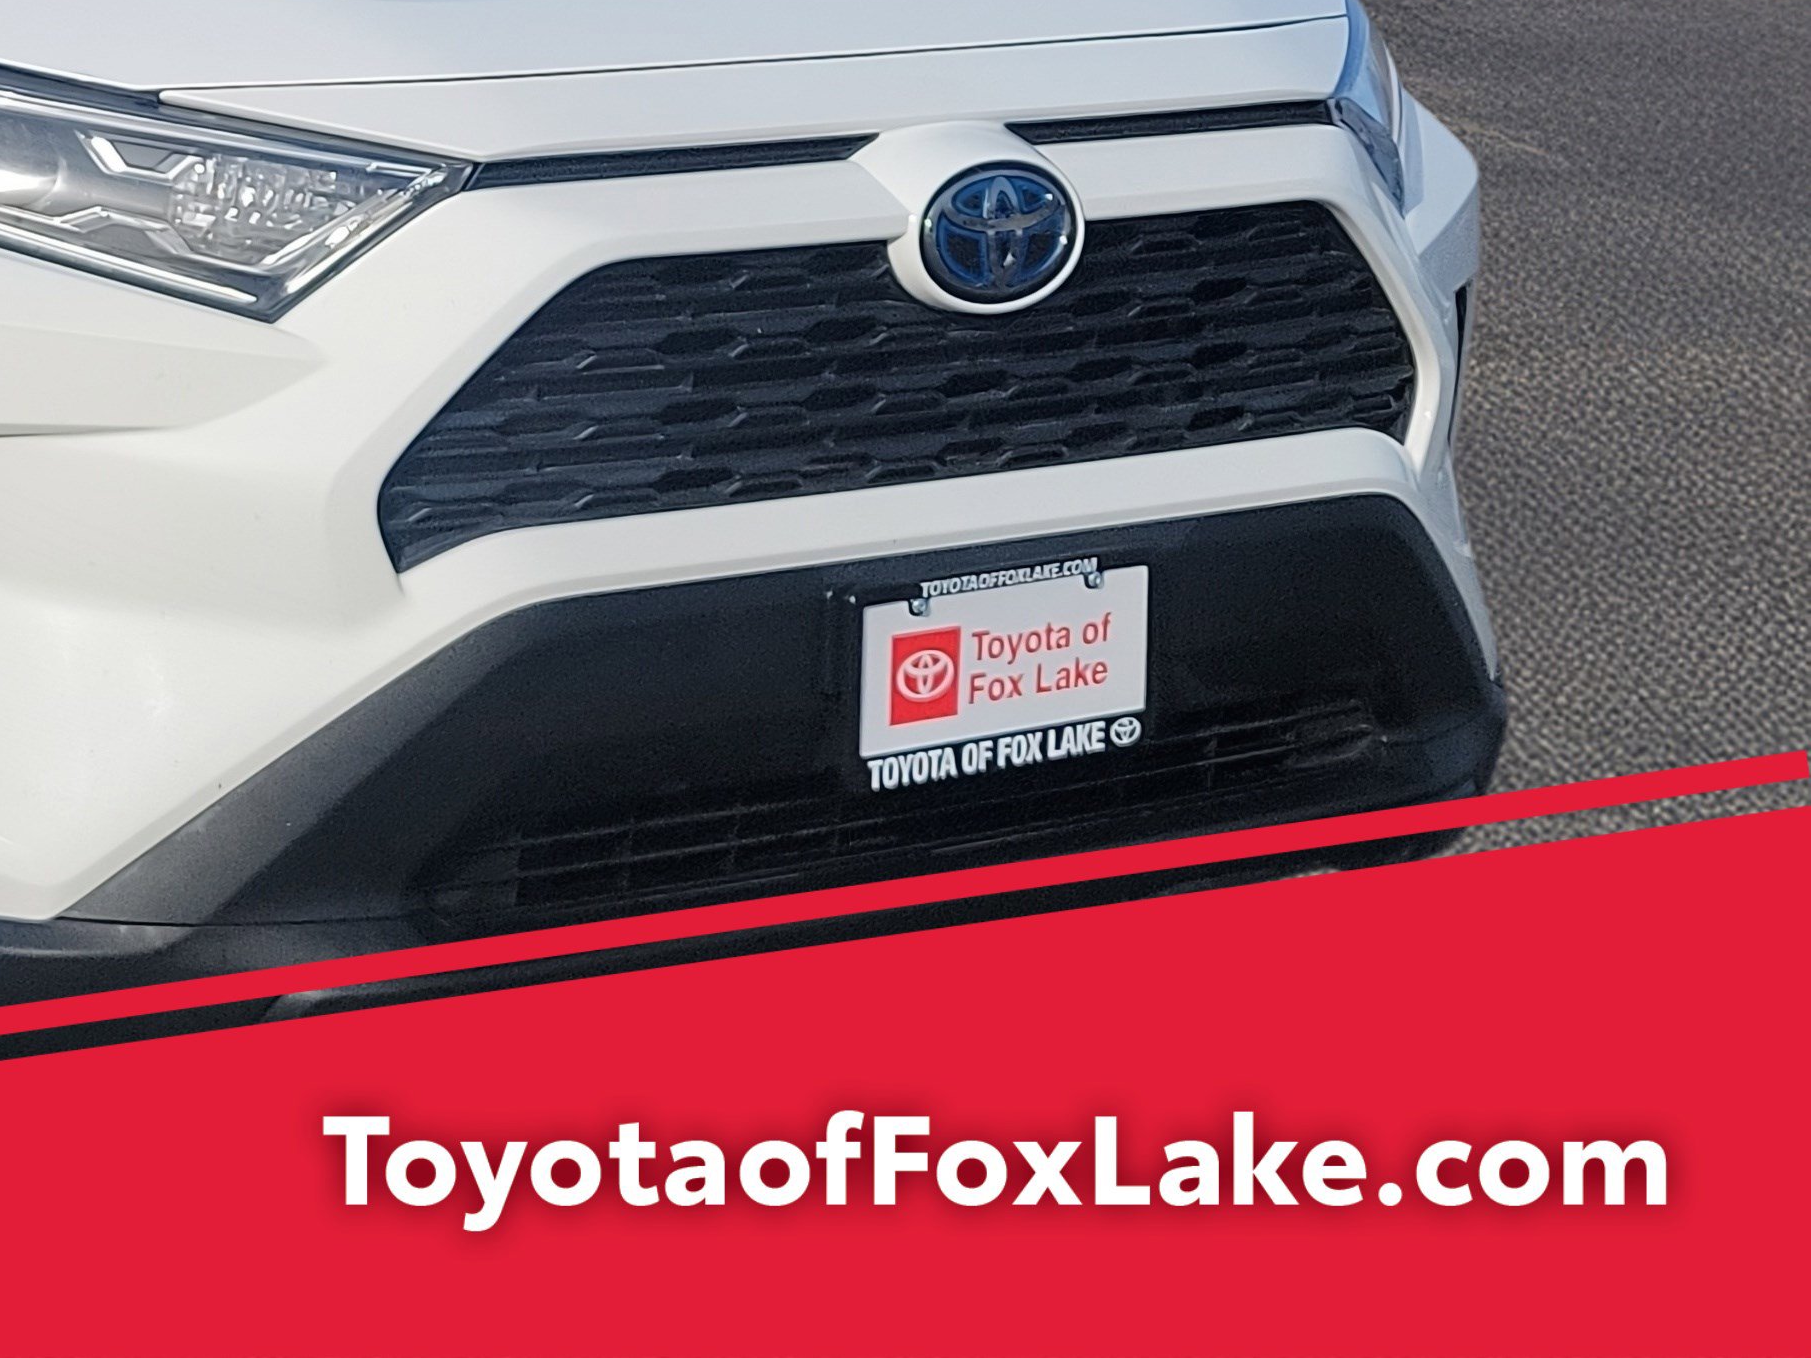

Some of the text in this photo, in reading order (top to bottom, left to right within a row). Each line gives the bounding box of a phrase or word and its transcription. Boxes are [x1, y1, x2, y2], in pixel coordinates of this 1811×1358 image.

[971, 612, 1112, 666] Toyota of
[969, 656, 1109, 704] Fox Lake
[867, 721, 1106, 792] TOYOTA OF FOX LAKE
